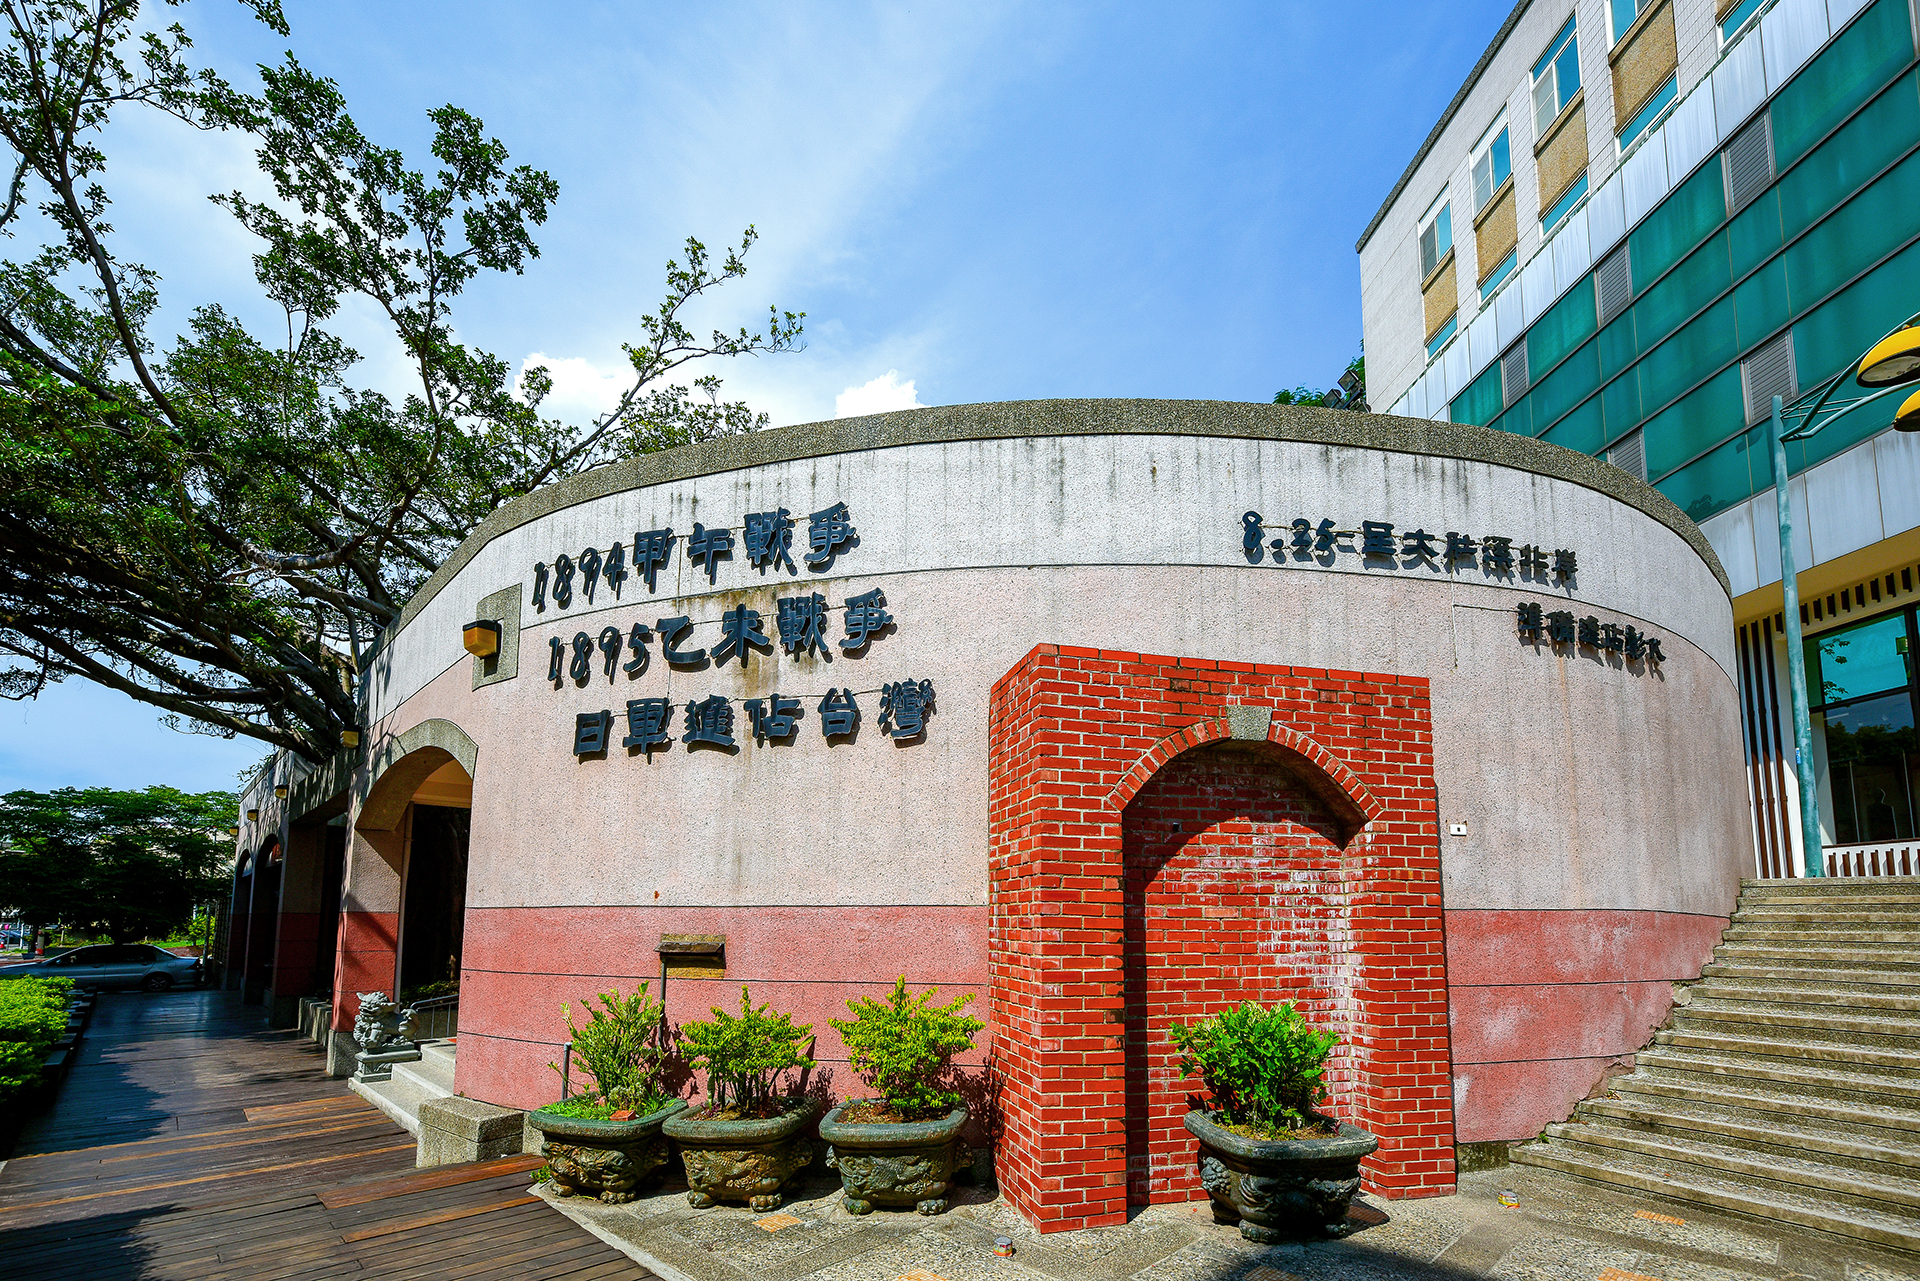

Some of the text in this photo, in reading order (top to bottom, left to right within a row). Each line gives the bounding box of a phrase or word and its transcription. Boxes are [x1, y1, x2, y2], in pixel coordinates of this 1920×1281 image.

[531, 501, 857, 606] 1894甲午戰爭
[548, 587, 894, 682] 1895乙未戰爭
[573, 678, 934, 757] 日軍進佔台灣
